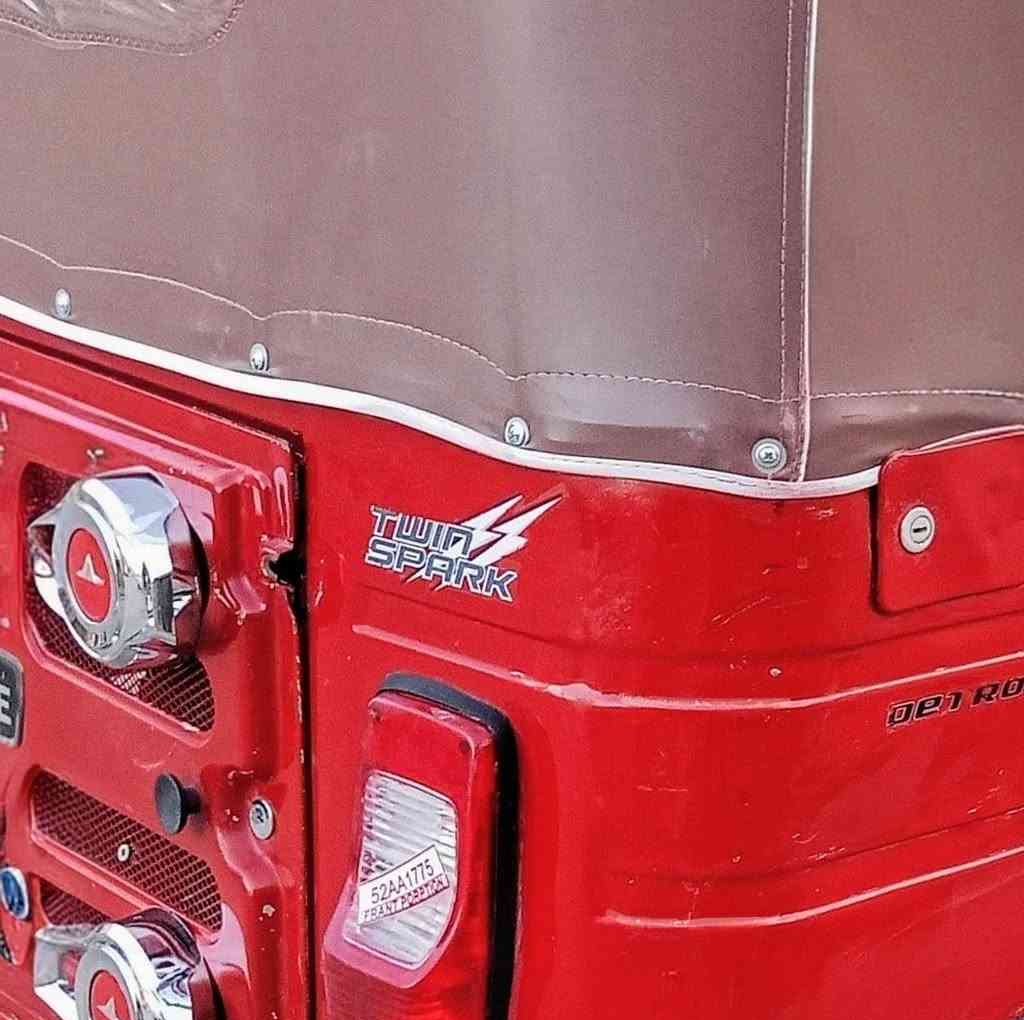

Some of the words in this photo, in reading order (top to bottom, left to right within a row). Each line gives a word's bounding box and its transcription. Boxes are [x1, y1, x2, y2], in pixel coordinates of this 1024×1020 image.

[370, 506, 475, 556] TWIN
[364, 537, 516, 602] SPARK
[371, 859, 434, 905] 52AA1775
